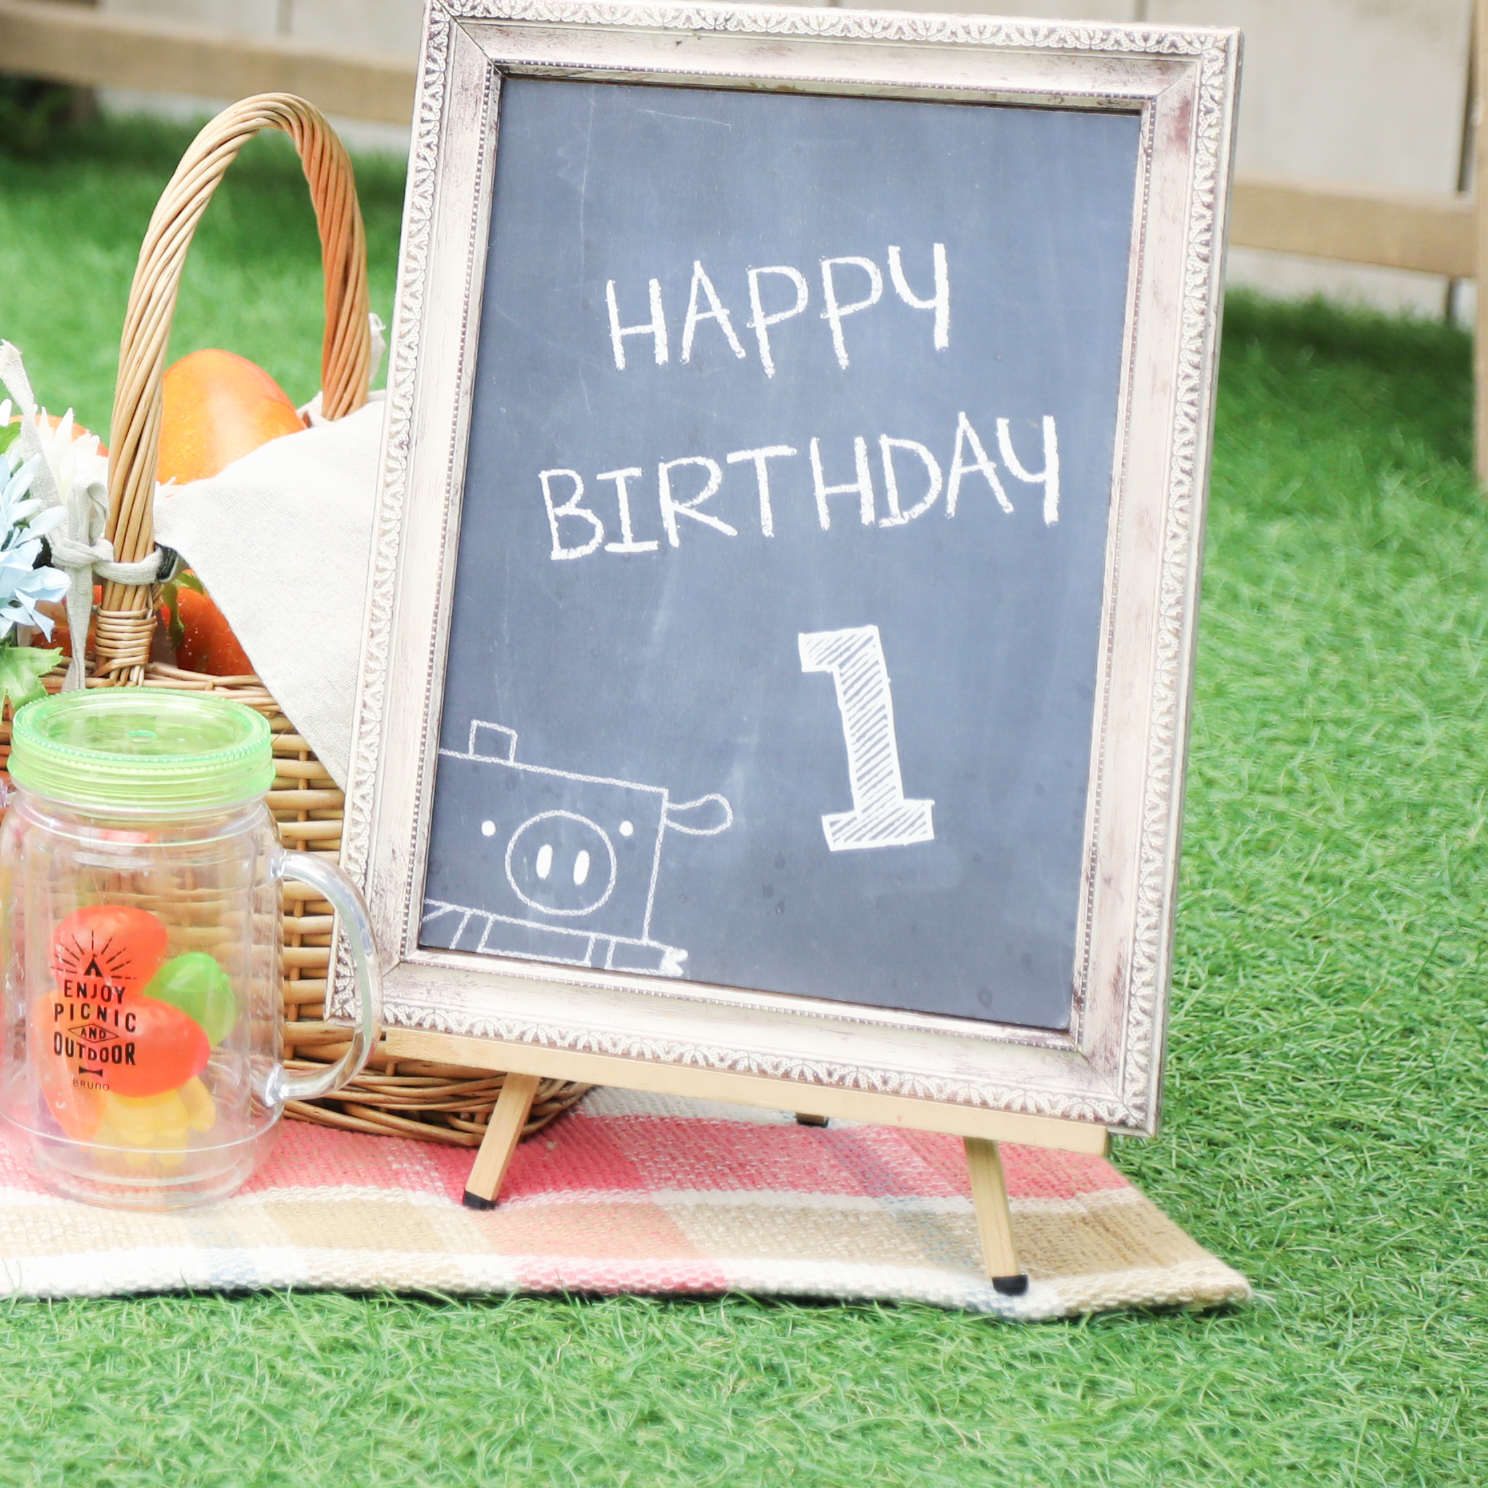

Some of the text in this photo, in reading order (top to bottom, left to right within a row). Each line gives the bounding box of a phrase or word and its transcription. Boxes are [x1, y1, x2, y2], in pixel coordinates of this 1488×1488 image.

[604, 241, 949, 378] HAPPY
[537, 412, 1059, 561] BIRTHDAY
[797, 624, 935, 853] 1
[63, 979, 126, 1005] ENJOY
[54, 1002, 137, 1033] PICNIC
[80, 1026, 107, 1040] AND
[53, 1031, 136, 1066] OUTDOOR
